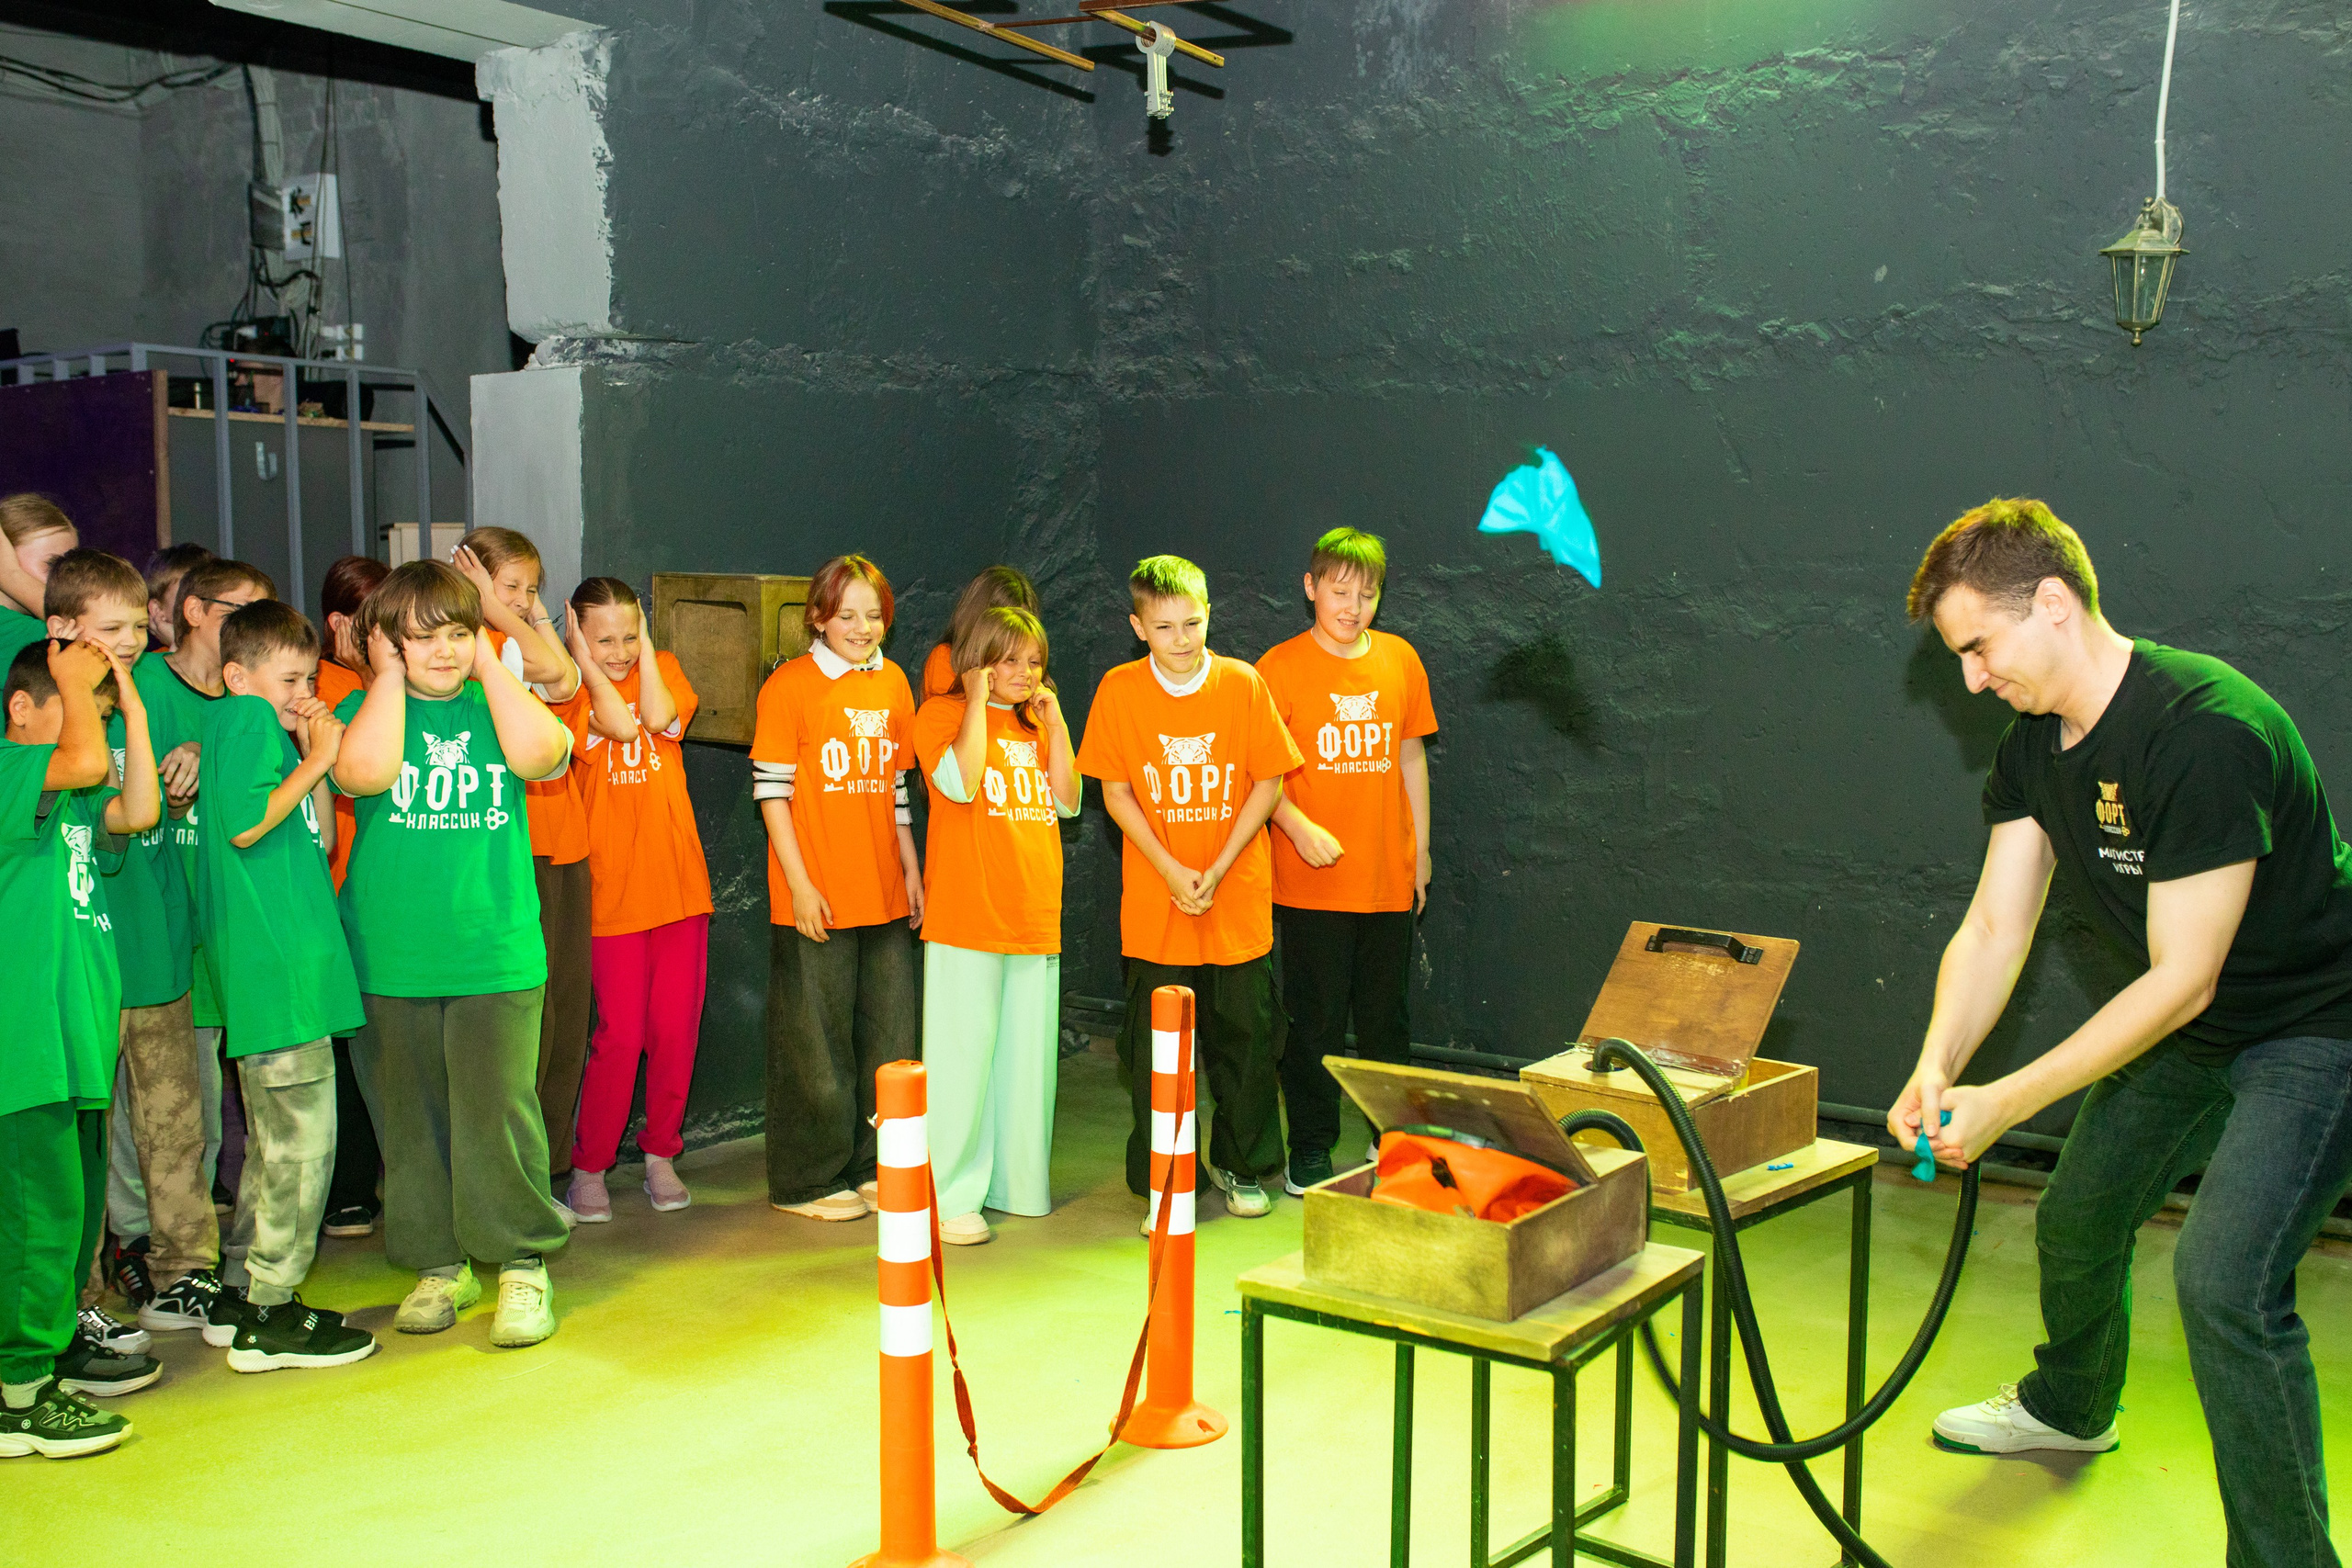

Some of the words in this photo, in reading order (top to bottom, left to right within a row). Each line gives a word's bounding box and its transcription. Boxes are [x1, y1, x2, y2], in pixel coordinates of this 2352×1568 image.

[1316, 722, 1393, 762] ФОРТ
[820, 738, 899, 782] ФОР
[1334, 760, 1383, 774] КЛАССИК
[390, 761, 507, 812] ФОРТ
[406, 812, 481, 829] КЛАССИК
[1007, 807, 1047, 822] КЛАССИ
[2096, 798, 2126, 826] ФОРТ
